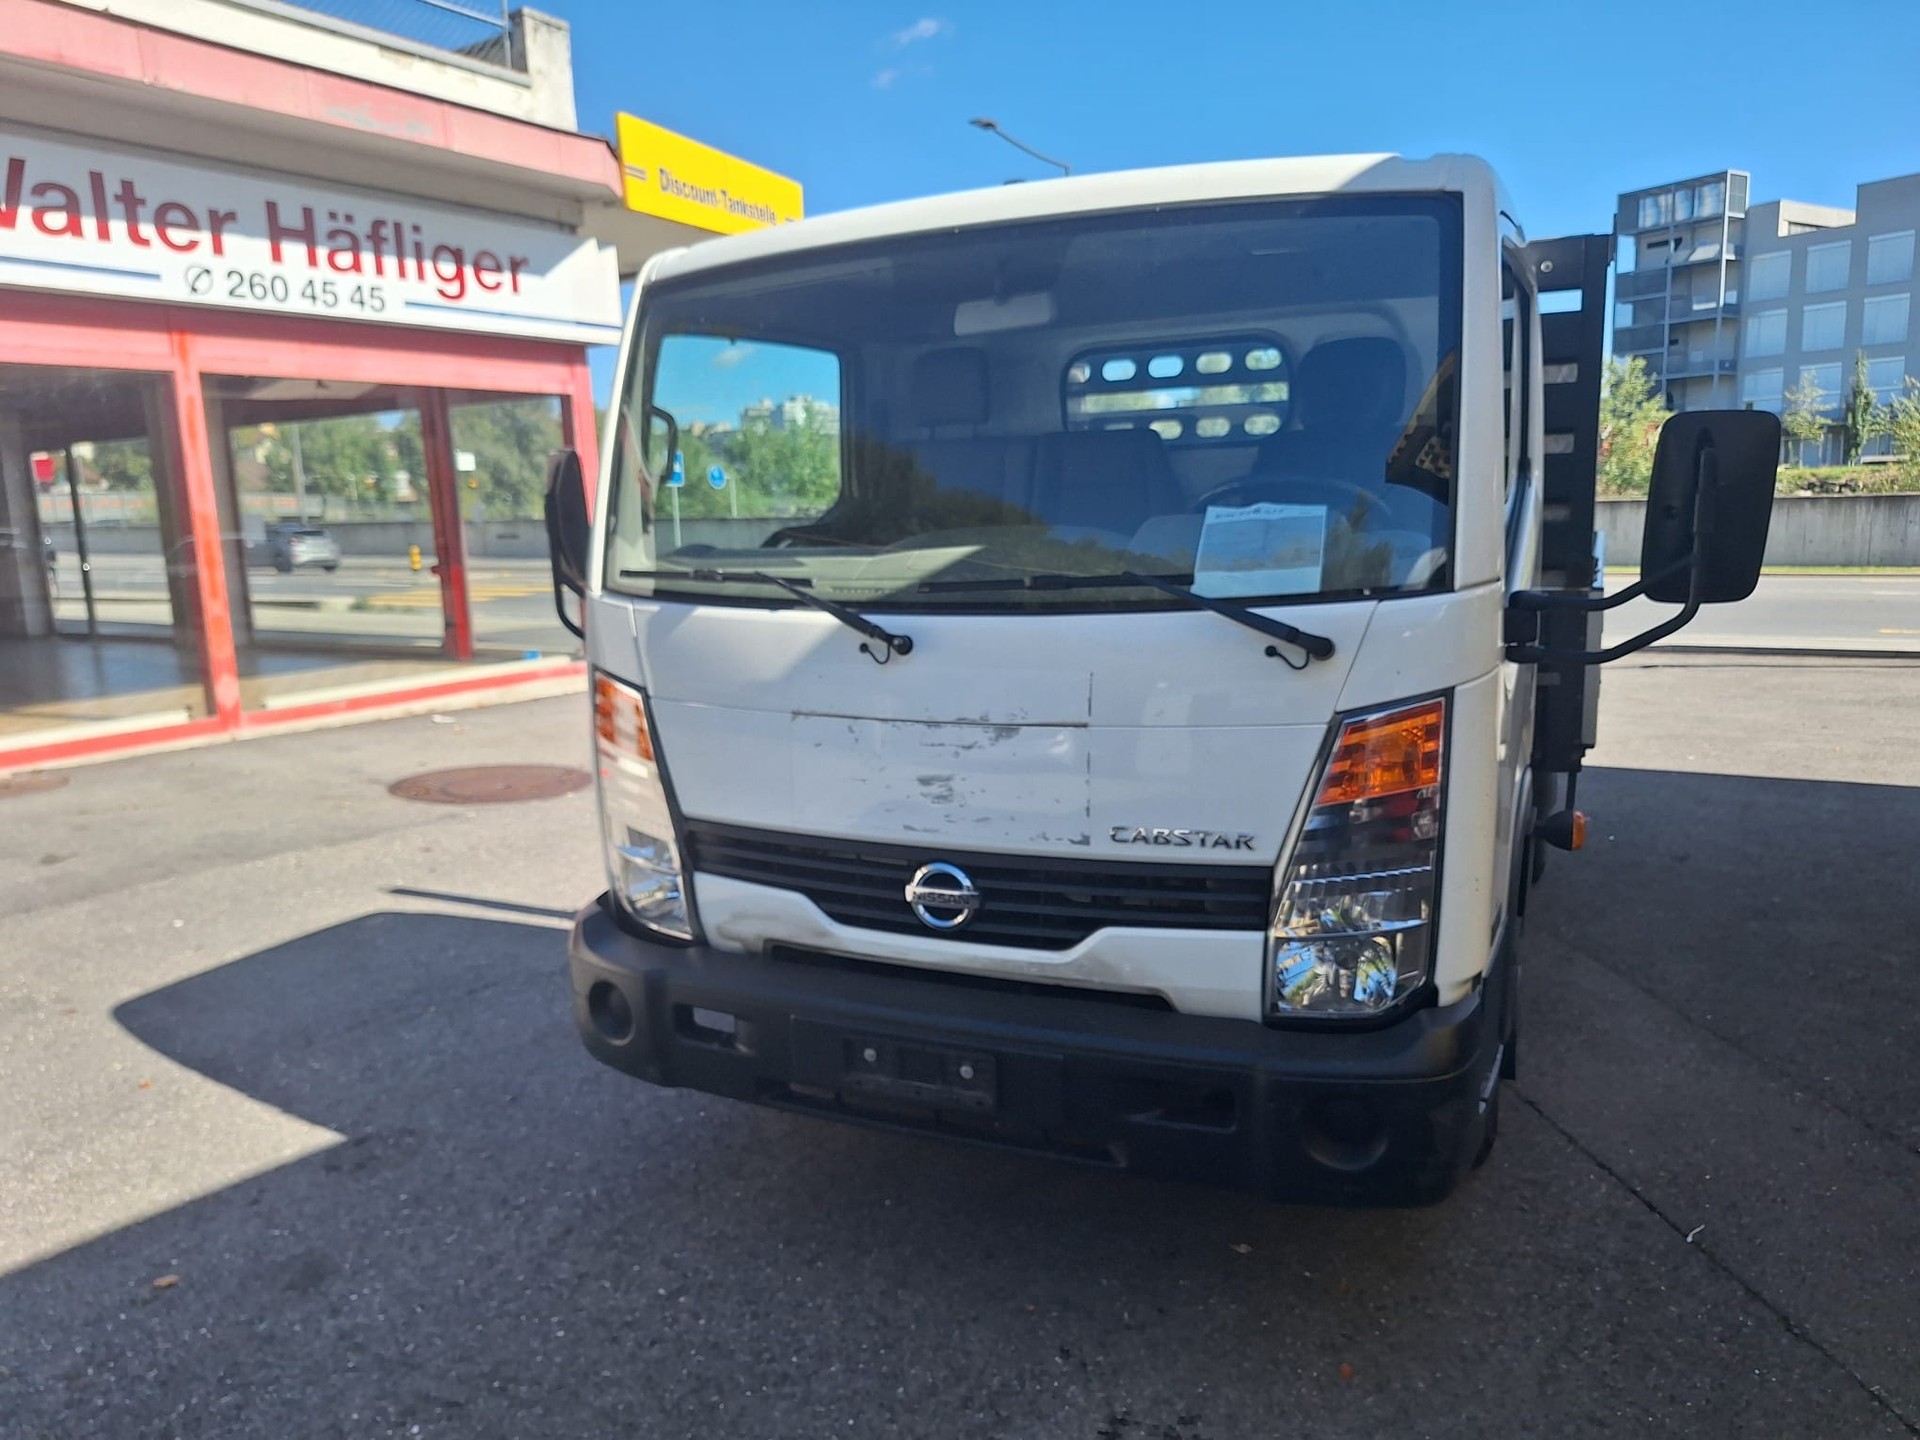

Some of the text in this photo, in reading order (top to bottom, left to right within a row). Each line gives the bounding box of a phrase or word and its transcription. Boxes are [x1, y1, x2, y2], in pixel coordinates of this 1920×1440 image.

[265, 201, 529, 301] Häfliger
[227, 270, 386, 313] 260 45 45
[1109, 826, 1256, 851] CABSTAR
